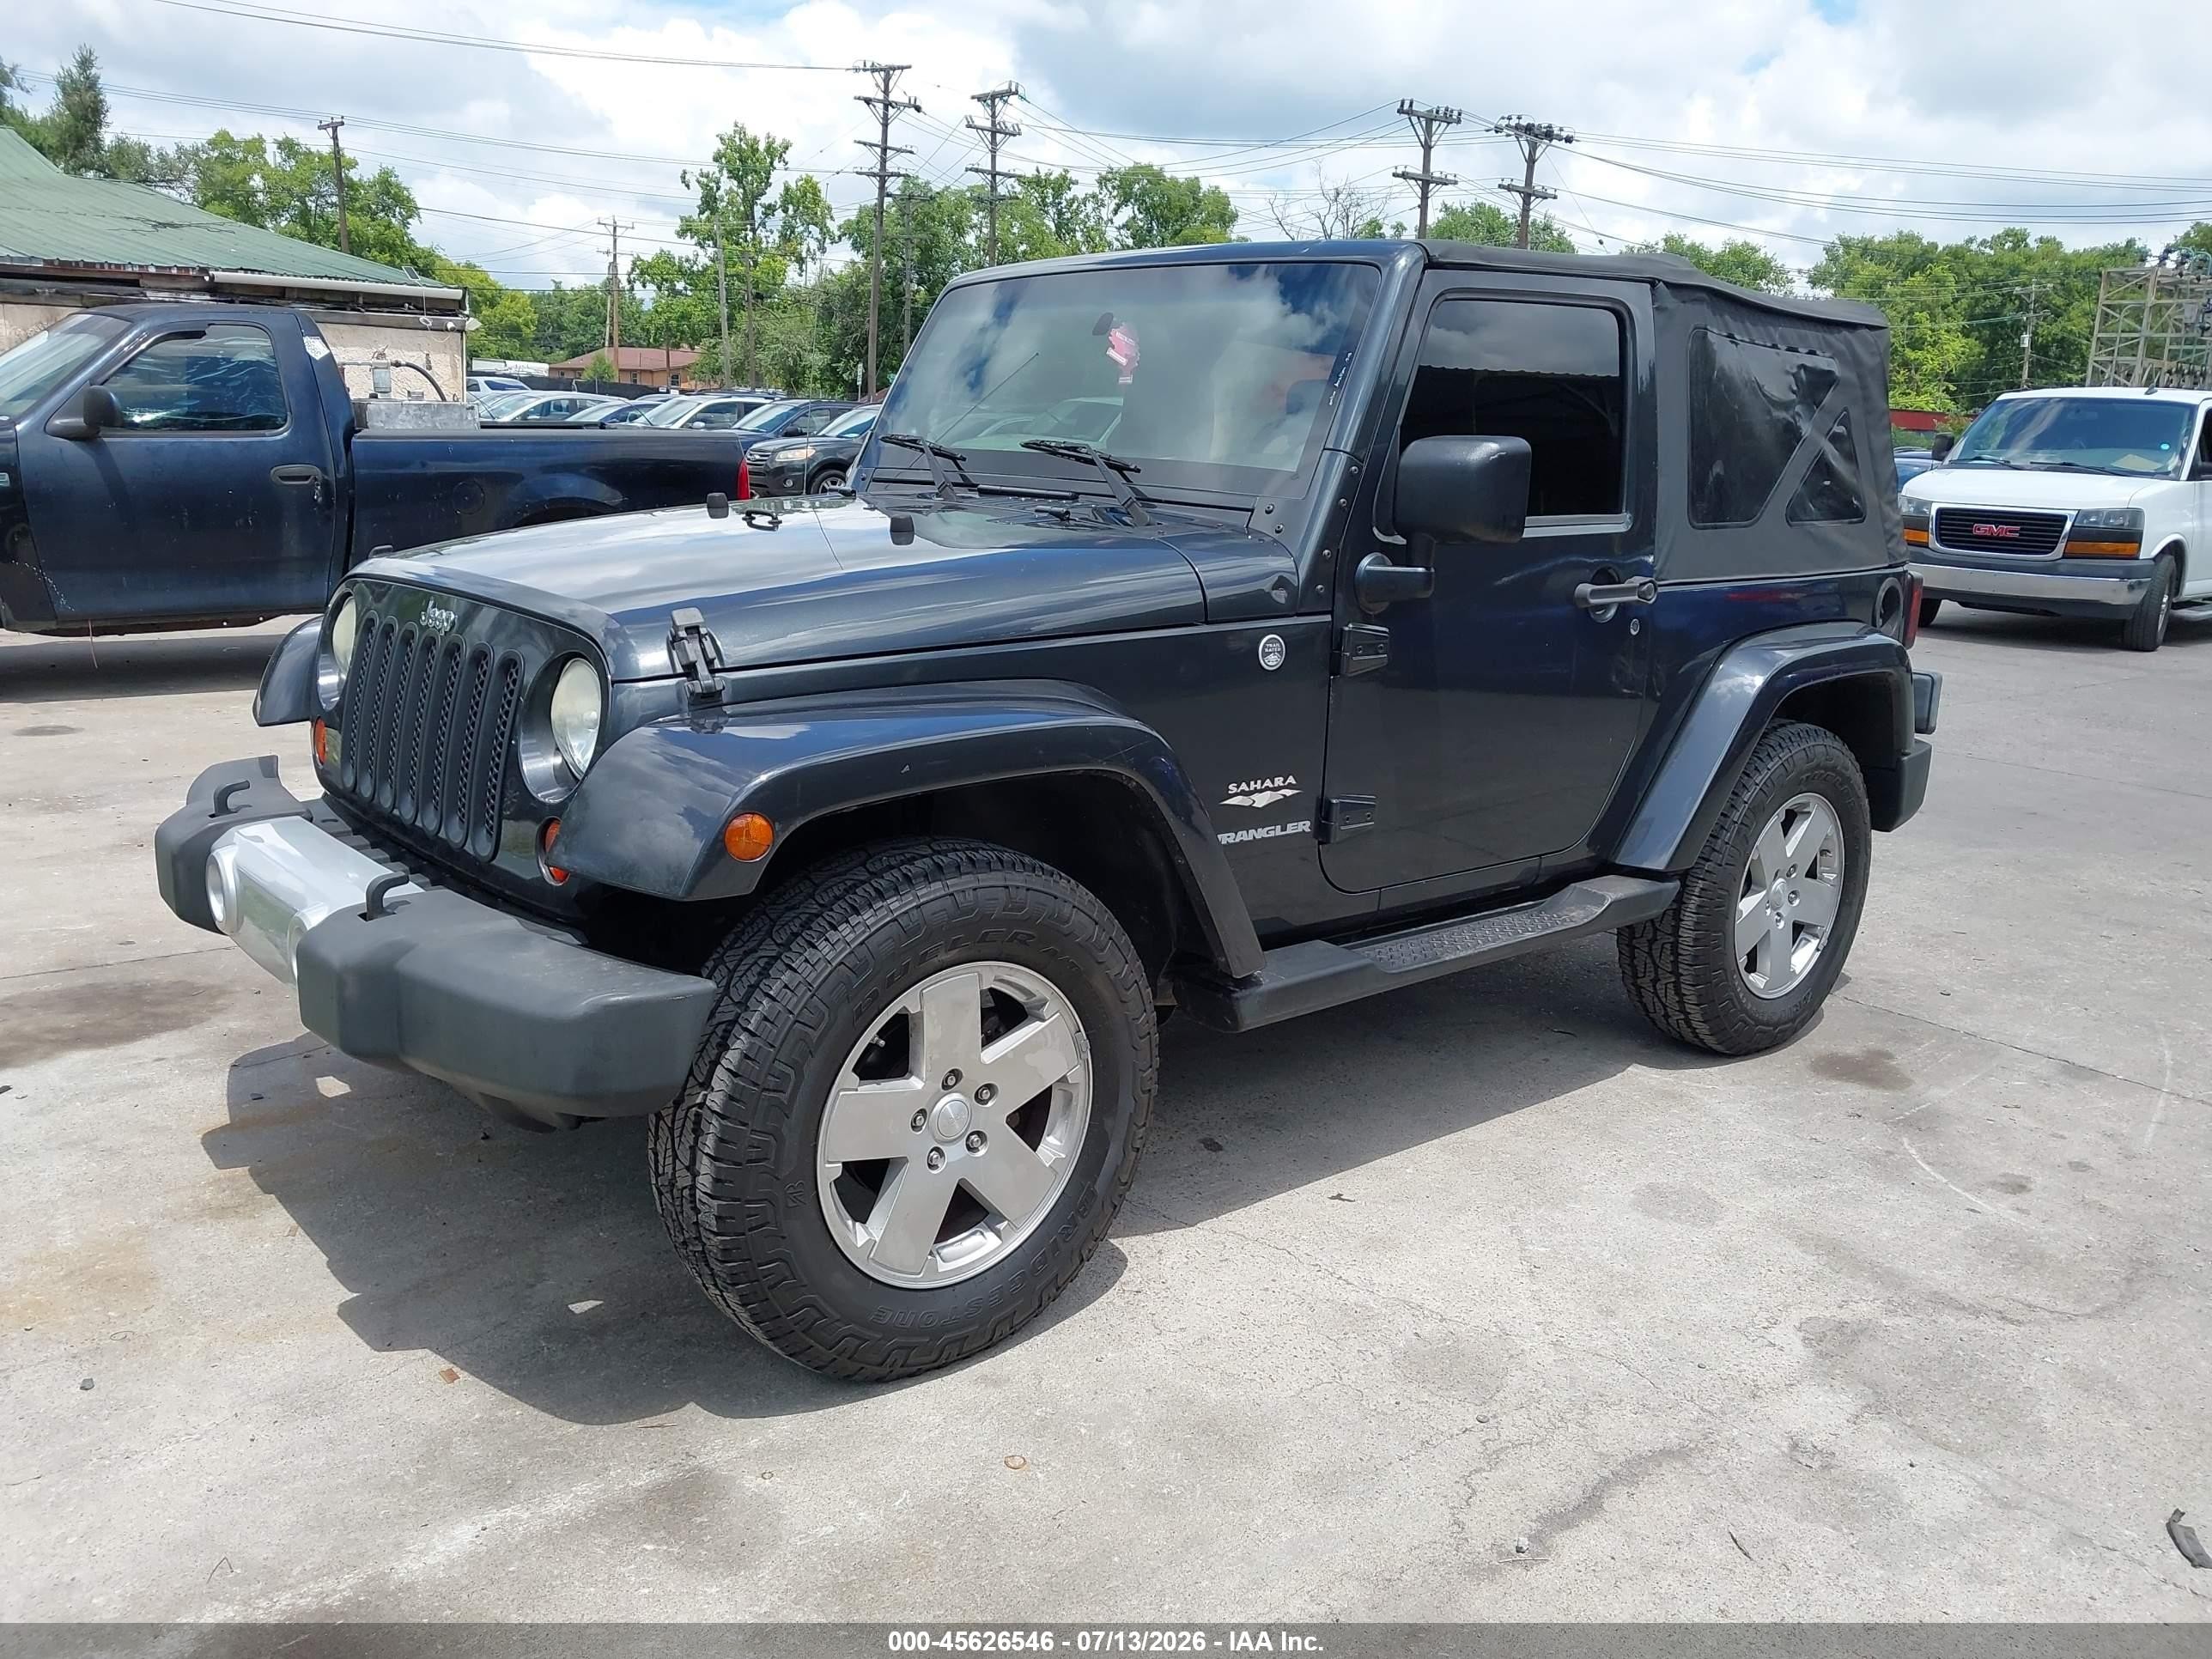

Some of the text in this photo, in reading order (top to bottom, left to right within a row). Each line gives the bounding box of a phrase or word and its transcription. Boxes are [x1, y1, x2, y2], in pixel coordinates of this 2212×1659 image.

[1972, 523, 2021, 537] GMC
[420, 596, 455, 635] Jeep
[1228, 775, 1297, 793] SAHARA
[869, 1180, 1100, 1328] BRIDGESTONE
